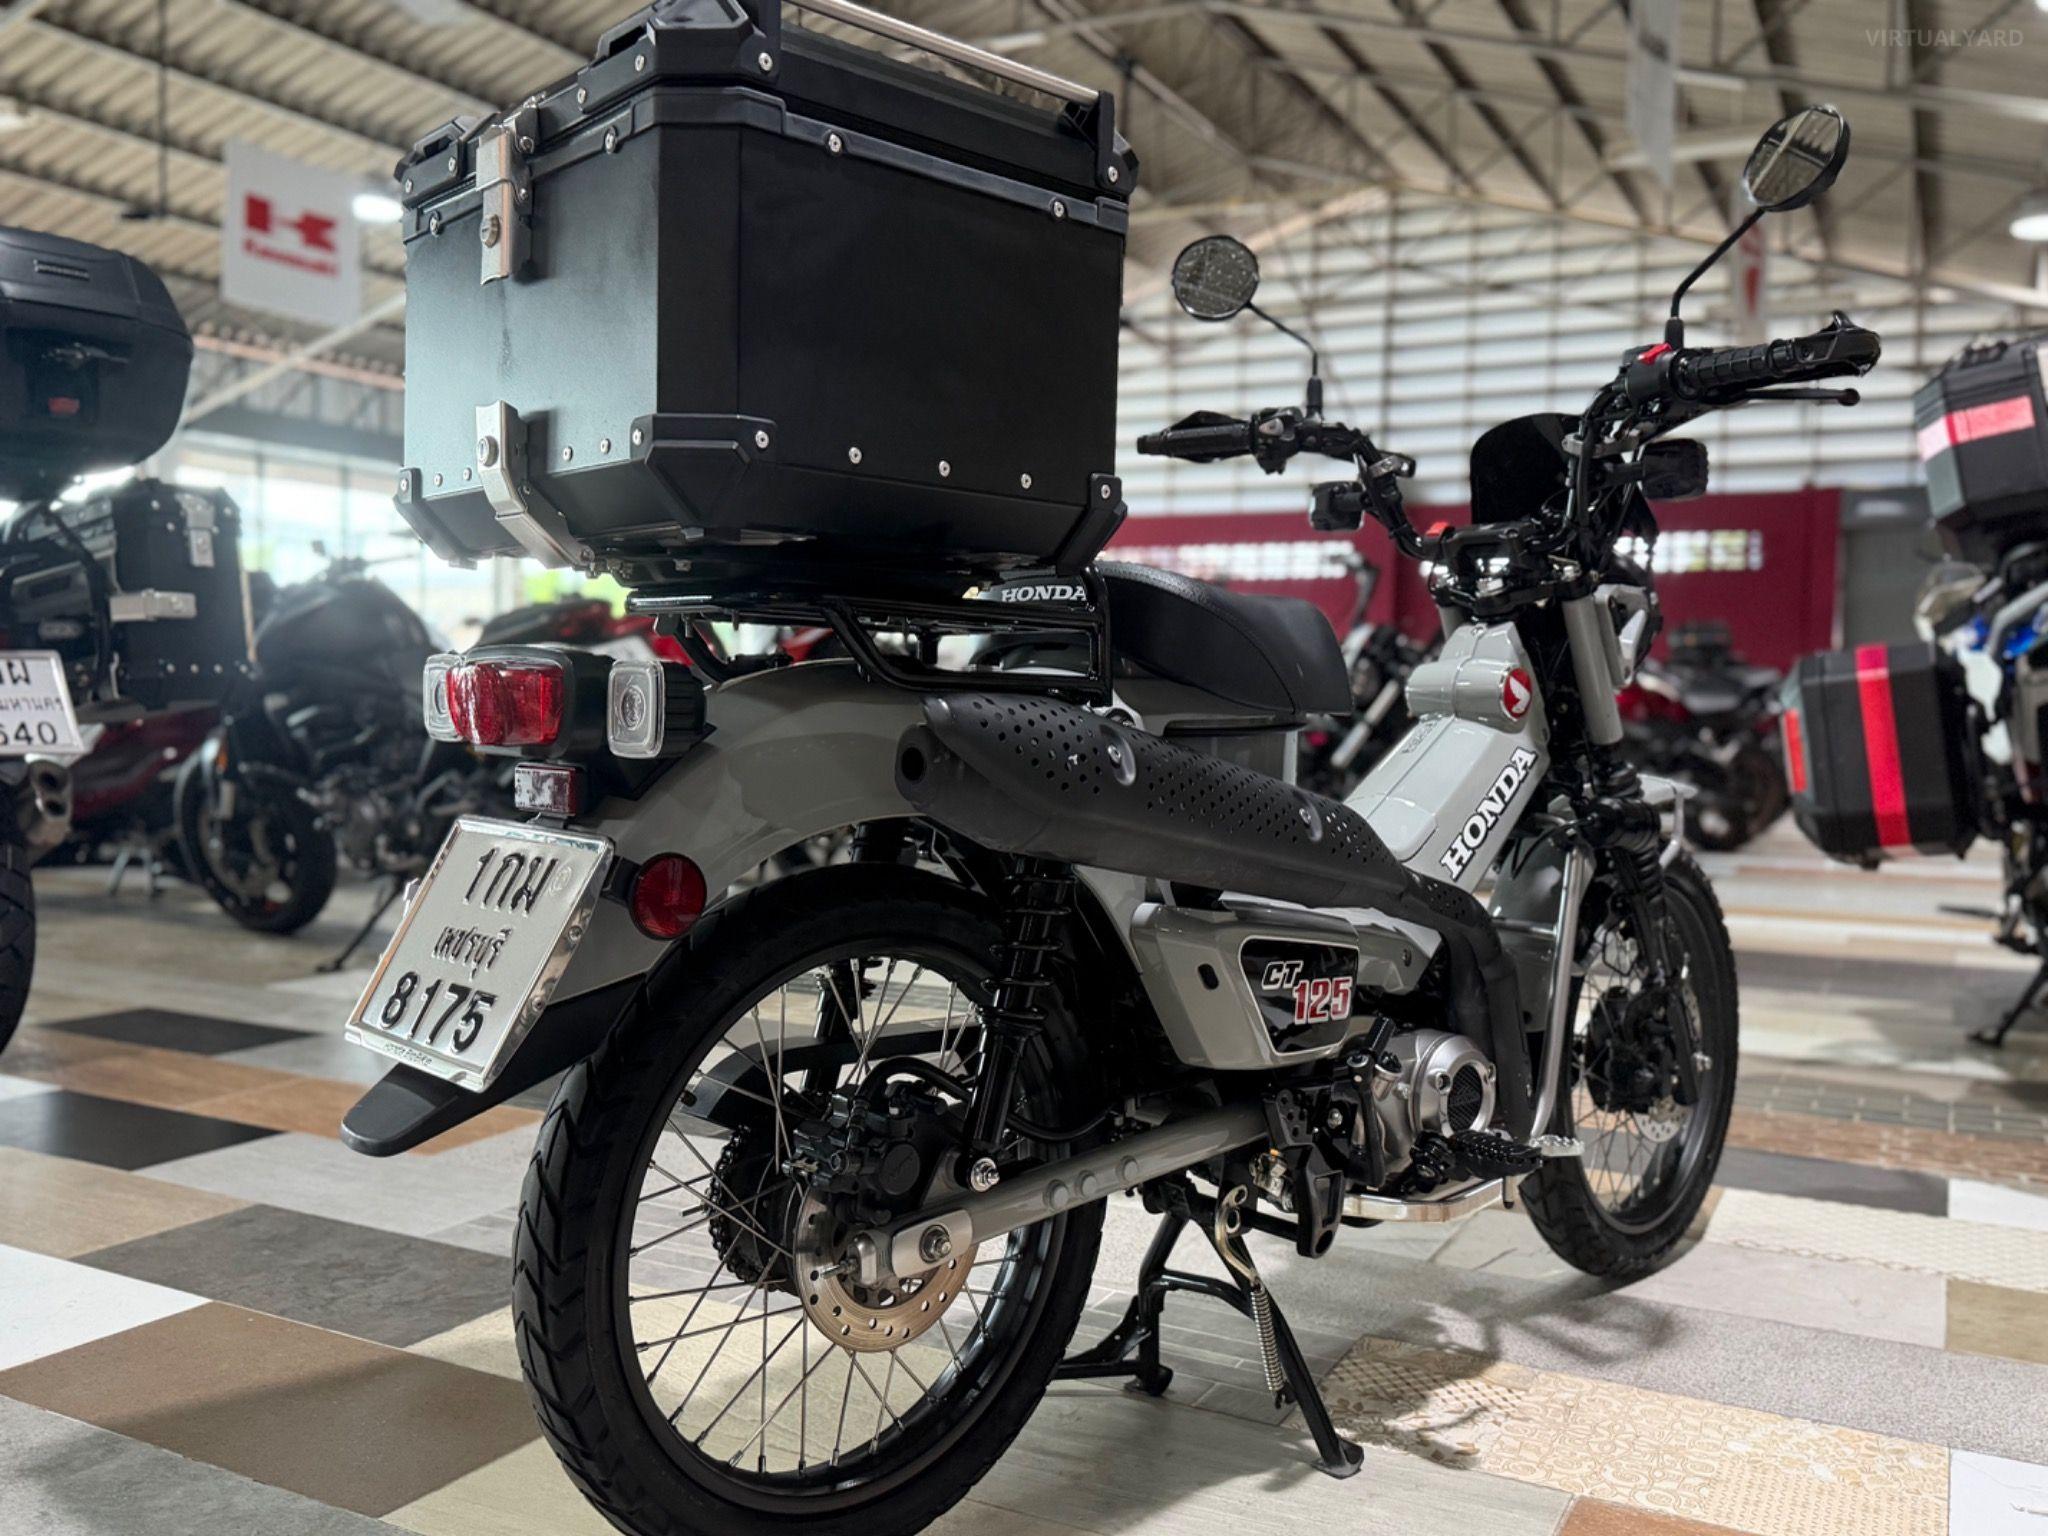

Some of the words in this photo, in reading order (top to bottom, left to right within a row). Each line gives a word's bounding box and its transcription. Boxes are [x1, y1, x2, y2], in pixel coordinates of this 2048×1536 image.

[1001, 585, 1087, 602] HONDA
[1440, 747, 1538, 881] HONDA
[380, 971, 498, 1053] 8175
[1262, 960, 1304, 990] CT
[1293, 976, 1353, 1025] 125
